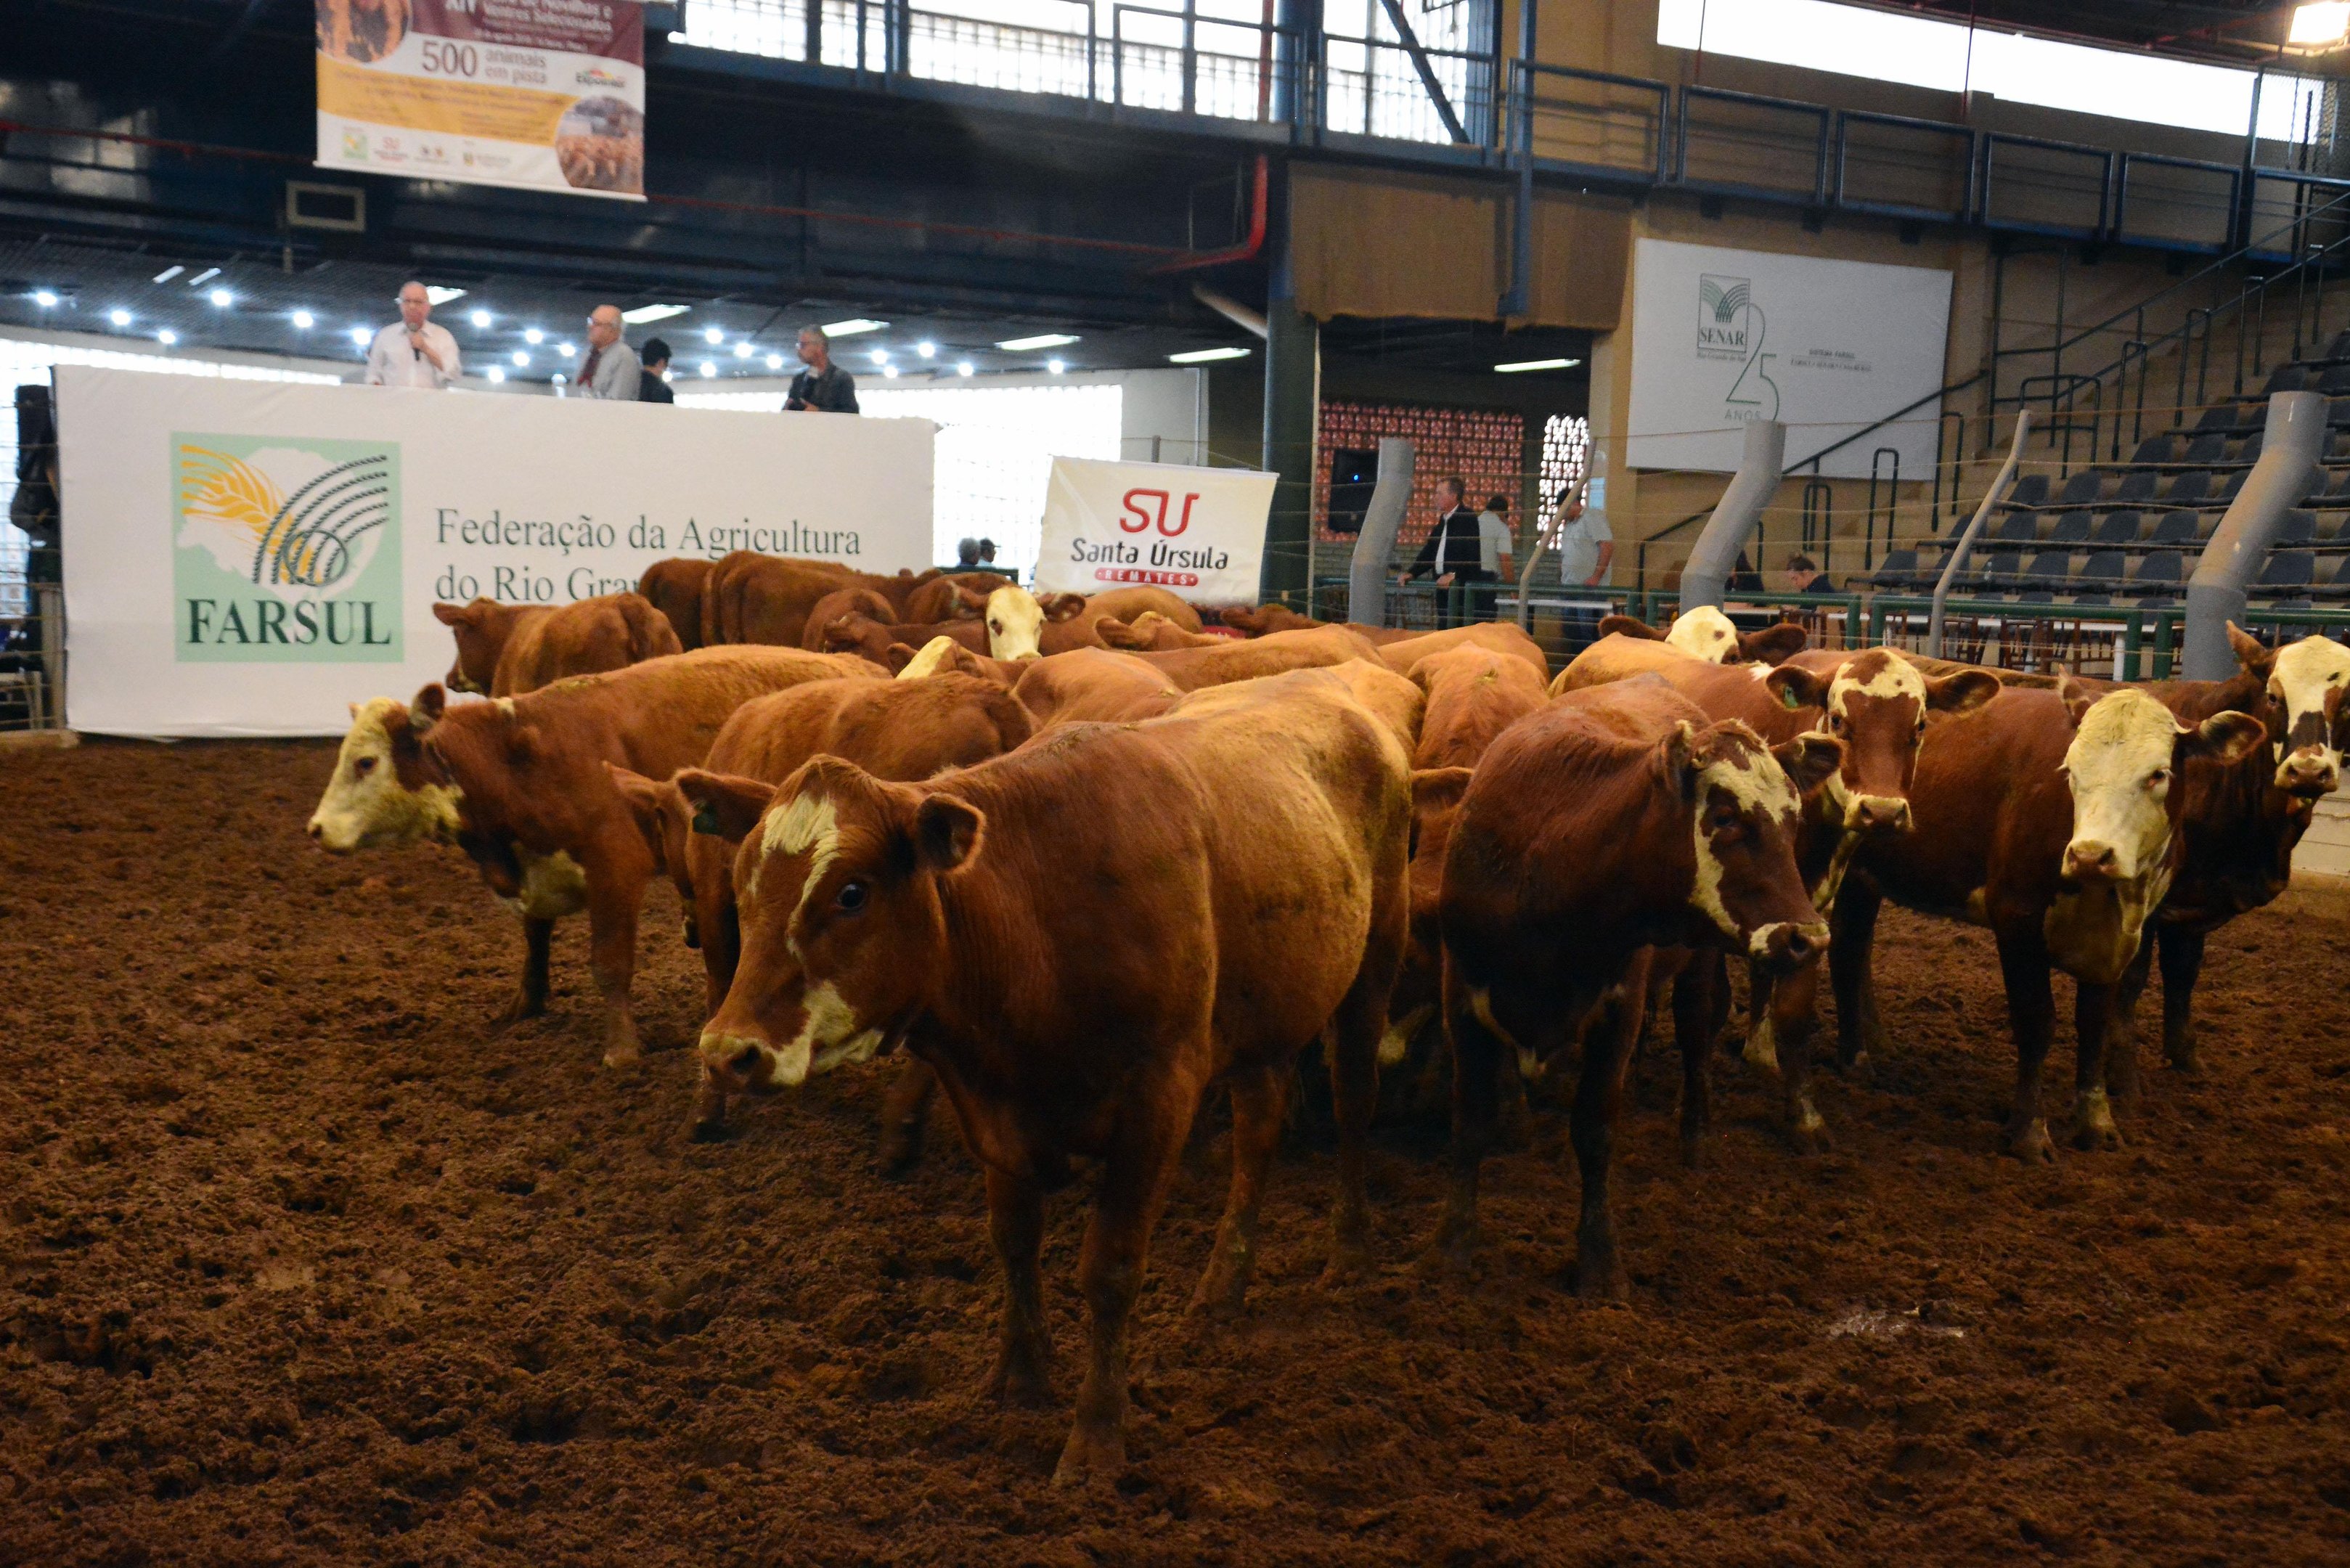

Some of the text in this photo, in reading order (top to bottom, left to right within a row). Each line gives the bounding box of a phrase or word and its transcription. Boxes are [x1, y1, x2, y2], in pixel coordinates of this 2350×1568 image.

[423, 41, 477, 77] 500
[486, 49, 546, 68] animais
[486, 66, 546, 85] em pista
[1700, 327, 1745, 346] SENAR
[1119, 487, 1200, 537] SU
[437, 508, 861, 561] Federação da Agricultura
[1071, 537, 1229, 570] Santa Úrsula
[436, 564, 479, 600] do
[494, 565, 553, 601] Rio
[1104, 570, 1188, 585] REMATES
[186, 598, 392, 645] FARSUL
